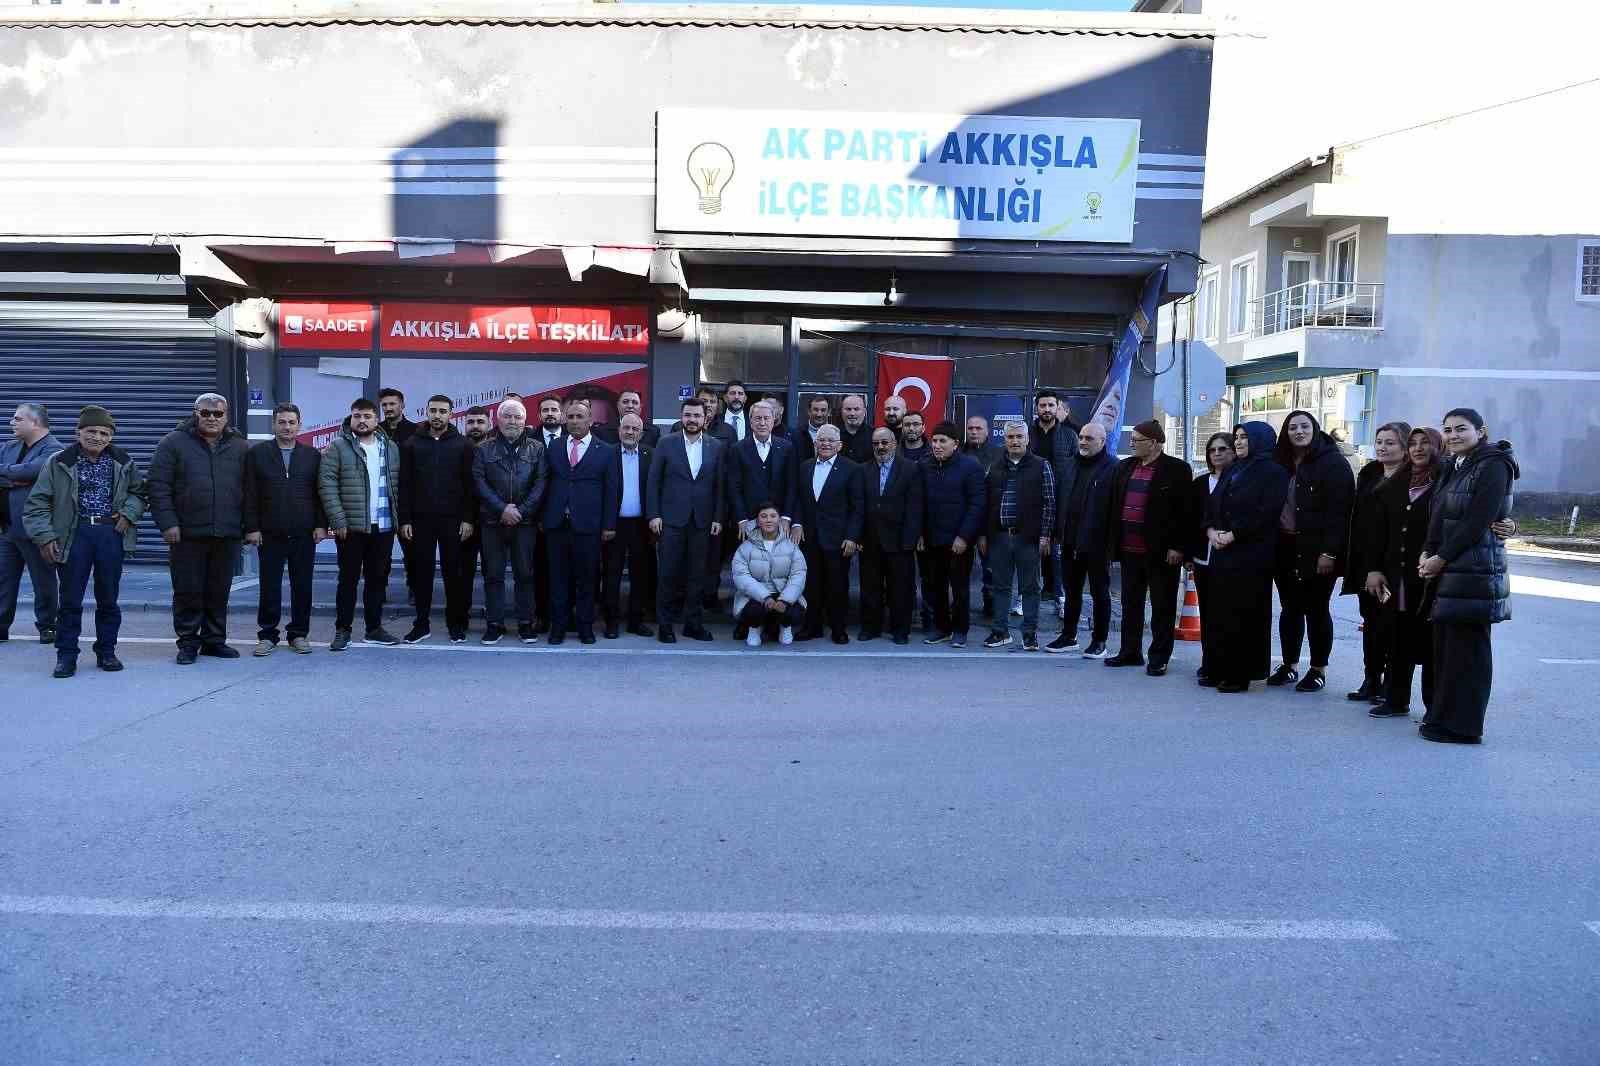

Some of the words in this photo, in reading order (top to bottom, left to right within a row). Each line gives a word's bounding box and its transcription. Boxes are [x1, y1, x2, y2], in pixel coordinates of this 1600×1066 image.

[762, 127, 811, 160] AK
[939, 131, 1098, 175] AKKIŞLA
[841, 178, 1042, 224] BAŞKANLIĞI
[304, 319, 368, 333] SAADET
[390, 320, 480, 341] AKKIŞLA
[487, 318, 530, 343] İLÇE
